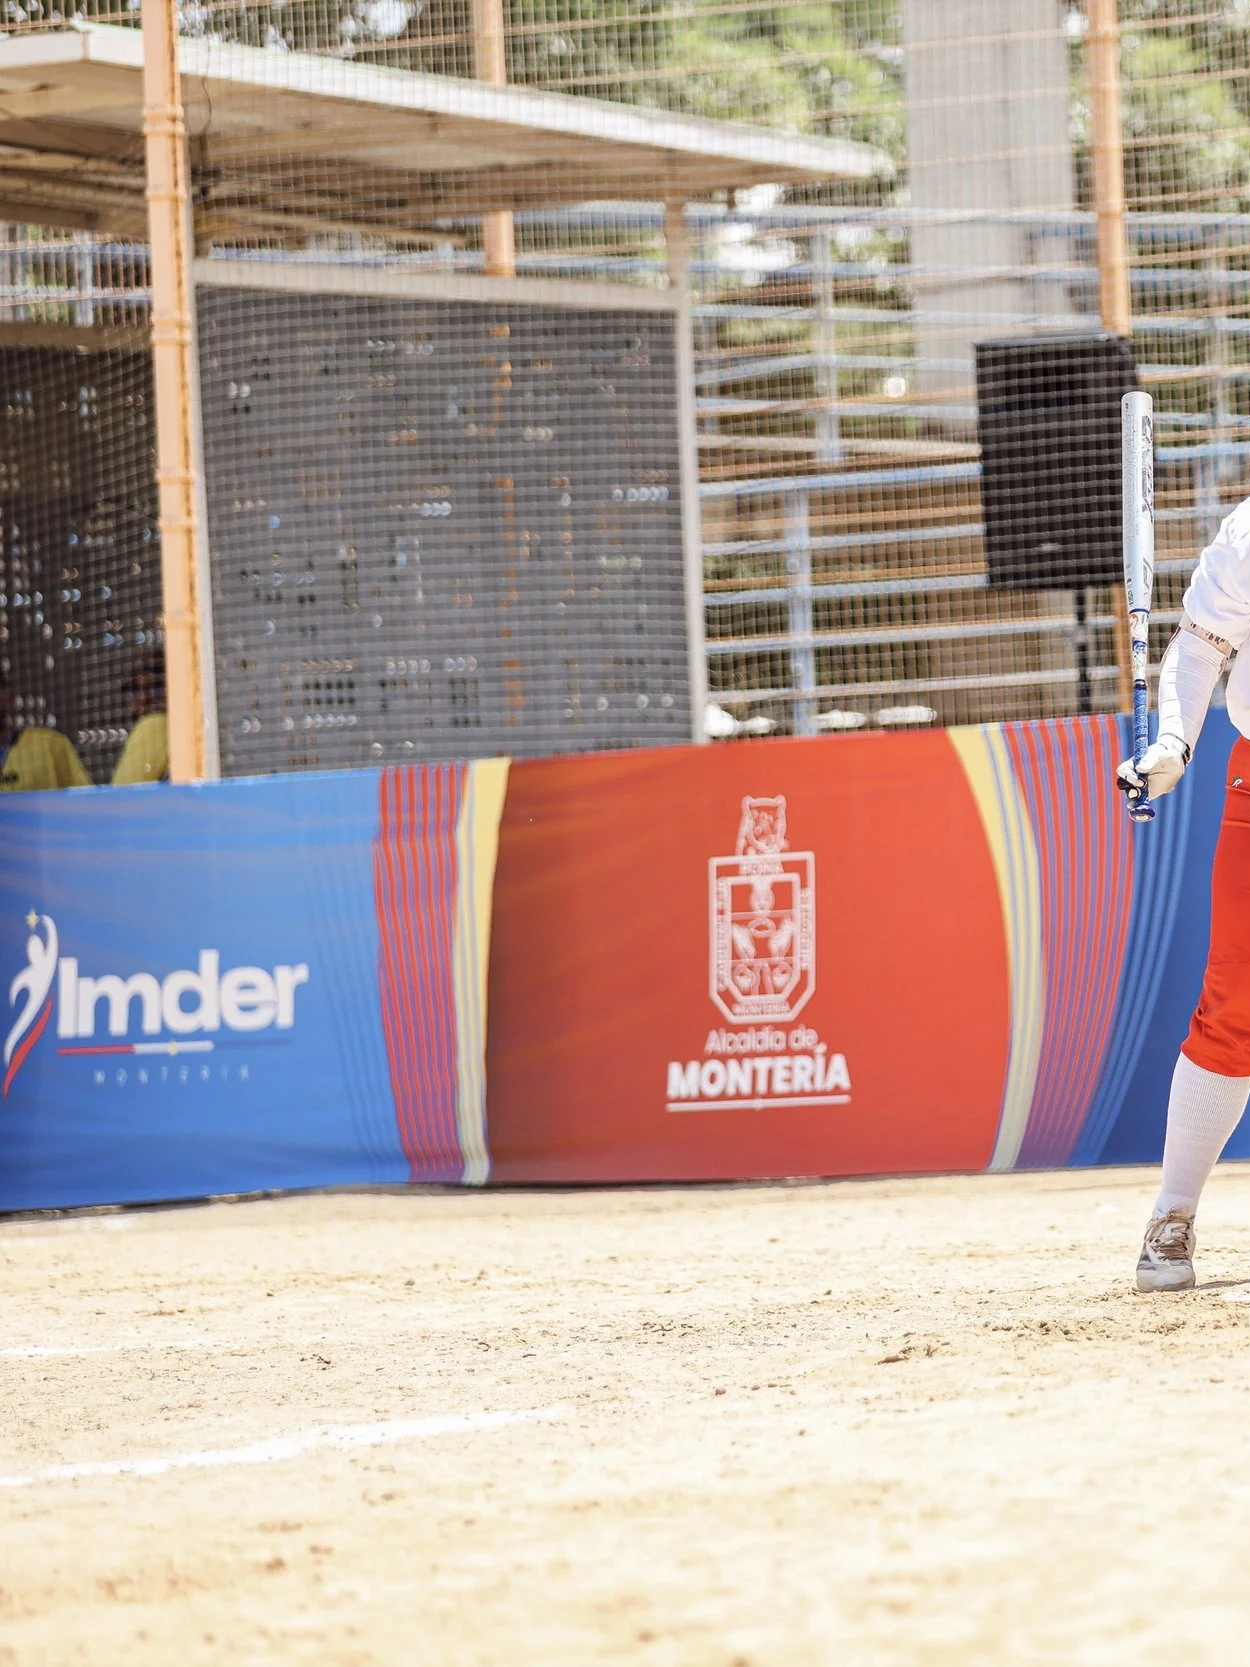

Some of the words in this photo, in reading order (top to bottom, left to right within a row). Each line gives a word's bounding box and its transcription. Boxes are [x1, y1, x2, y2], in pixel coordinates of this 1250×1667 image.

[57, 948, 309, 1040] Imder
[788, 1024, 818, 1050] de
[667, 1042, 852, 1099] MONTERÍA
